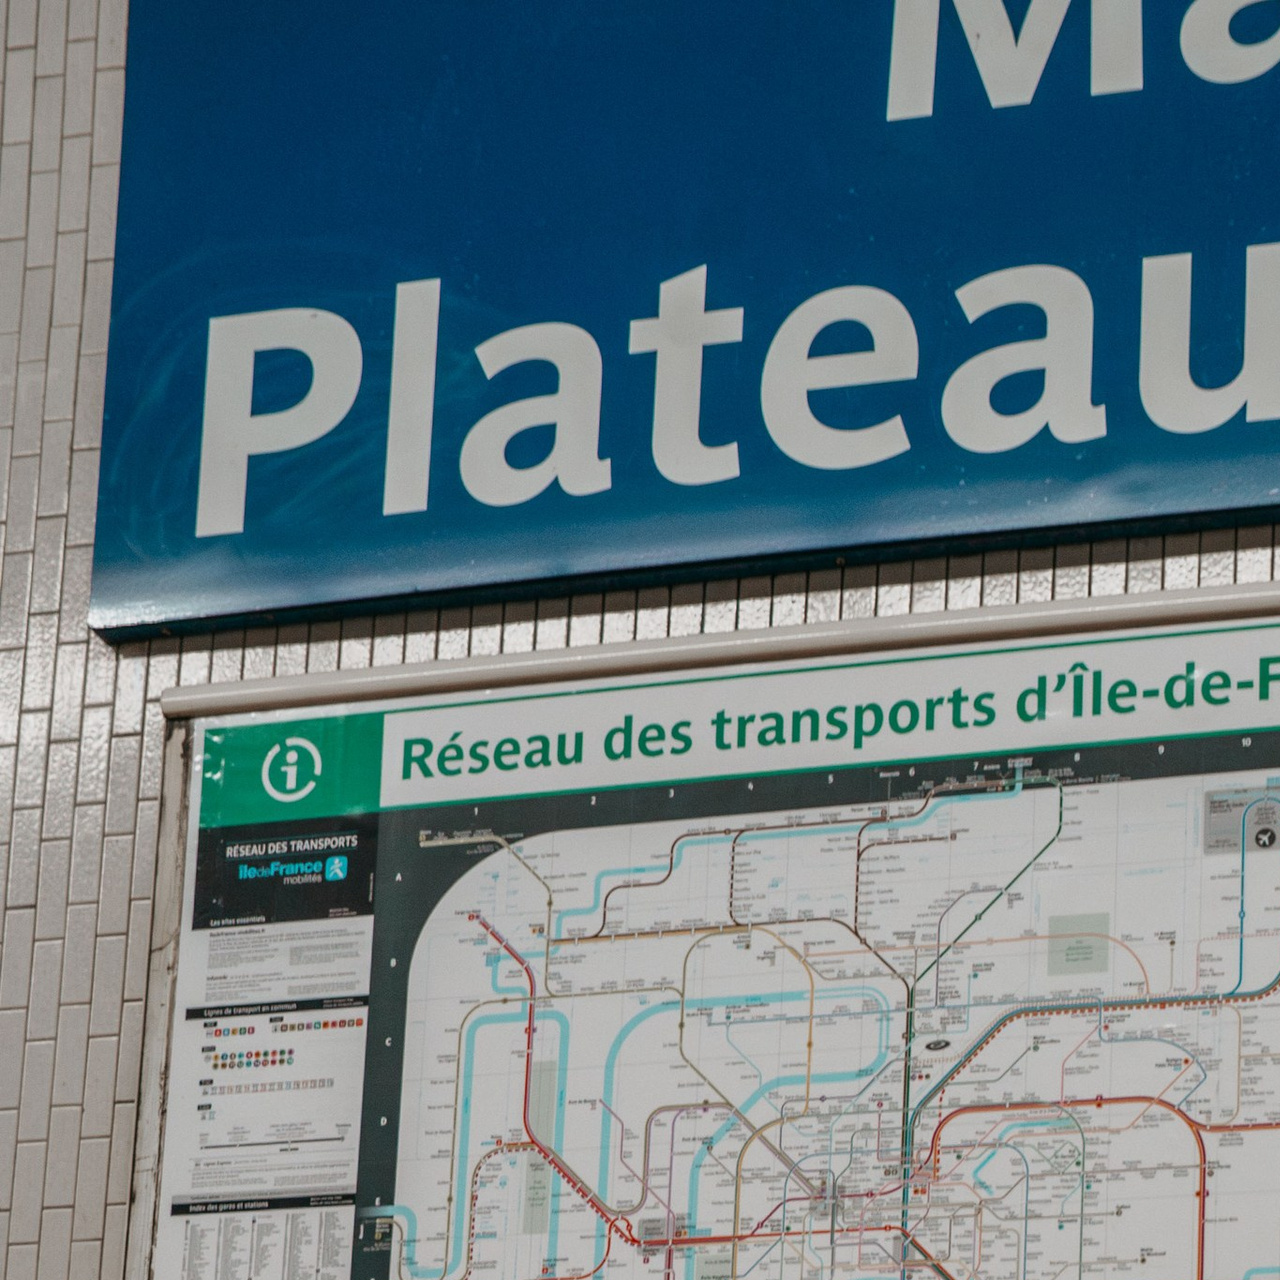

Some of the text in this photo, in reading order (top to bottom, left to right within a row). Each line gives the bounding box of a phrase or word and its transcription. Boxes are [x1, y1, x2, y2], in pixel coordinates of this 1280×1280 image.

[401, 728, 584, 781] Réseau
[604, 713, 694, 761] des
[711, 671, 997, 752] transports
[226, 834, 358, 859] RÉSEAU DES TRANSPORTS
